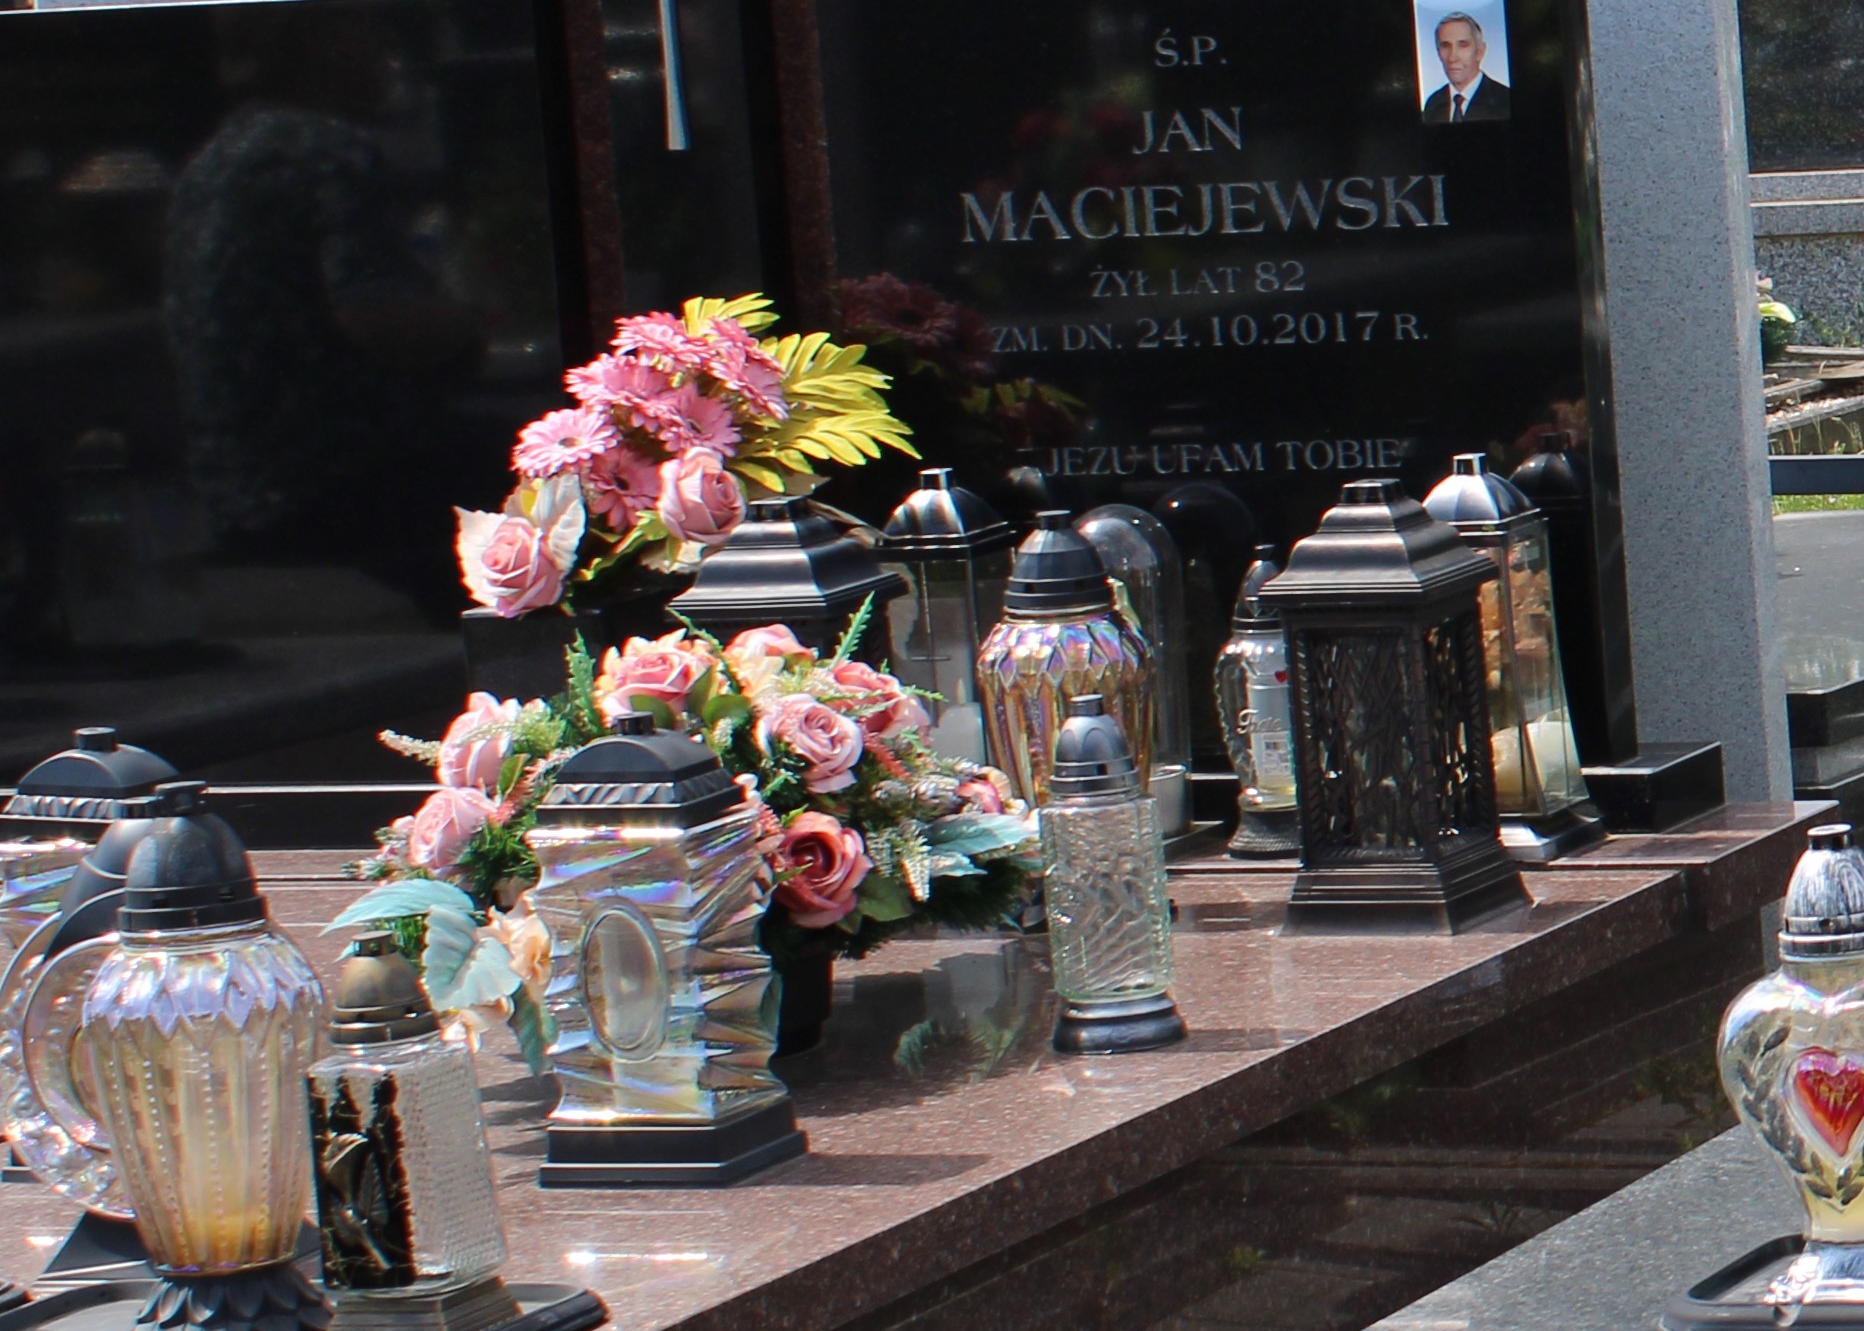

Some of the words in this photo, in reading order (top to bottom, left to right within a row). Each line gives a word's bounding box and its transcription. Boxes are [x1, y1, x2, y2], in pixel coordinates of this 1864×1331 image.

[1155, 29, 1226, 66] Ś.P.
[1133, 108, 1241, 154] JAN
[962, 175, 1449, 242] MACIEJEWSKI
[1092, 264, 1158, 298] ŻYŁ
[1171, 266, 1240, 296] LAT
[1255, 261, 1304, 292] 82
[990, 327, 1048, 353] ZM.
[1063, 324, 1121, 350] DN.
[1137, 311, 1379, 348] 24.10.2017
[1395, 313, 1427, 340] R.
[1045, 447, 1137, 477] JEZU
[1153, 442, 1264, 475] UFAM
[1276, 440, 1403, 470] TOBIE
